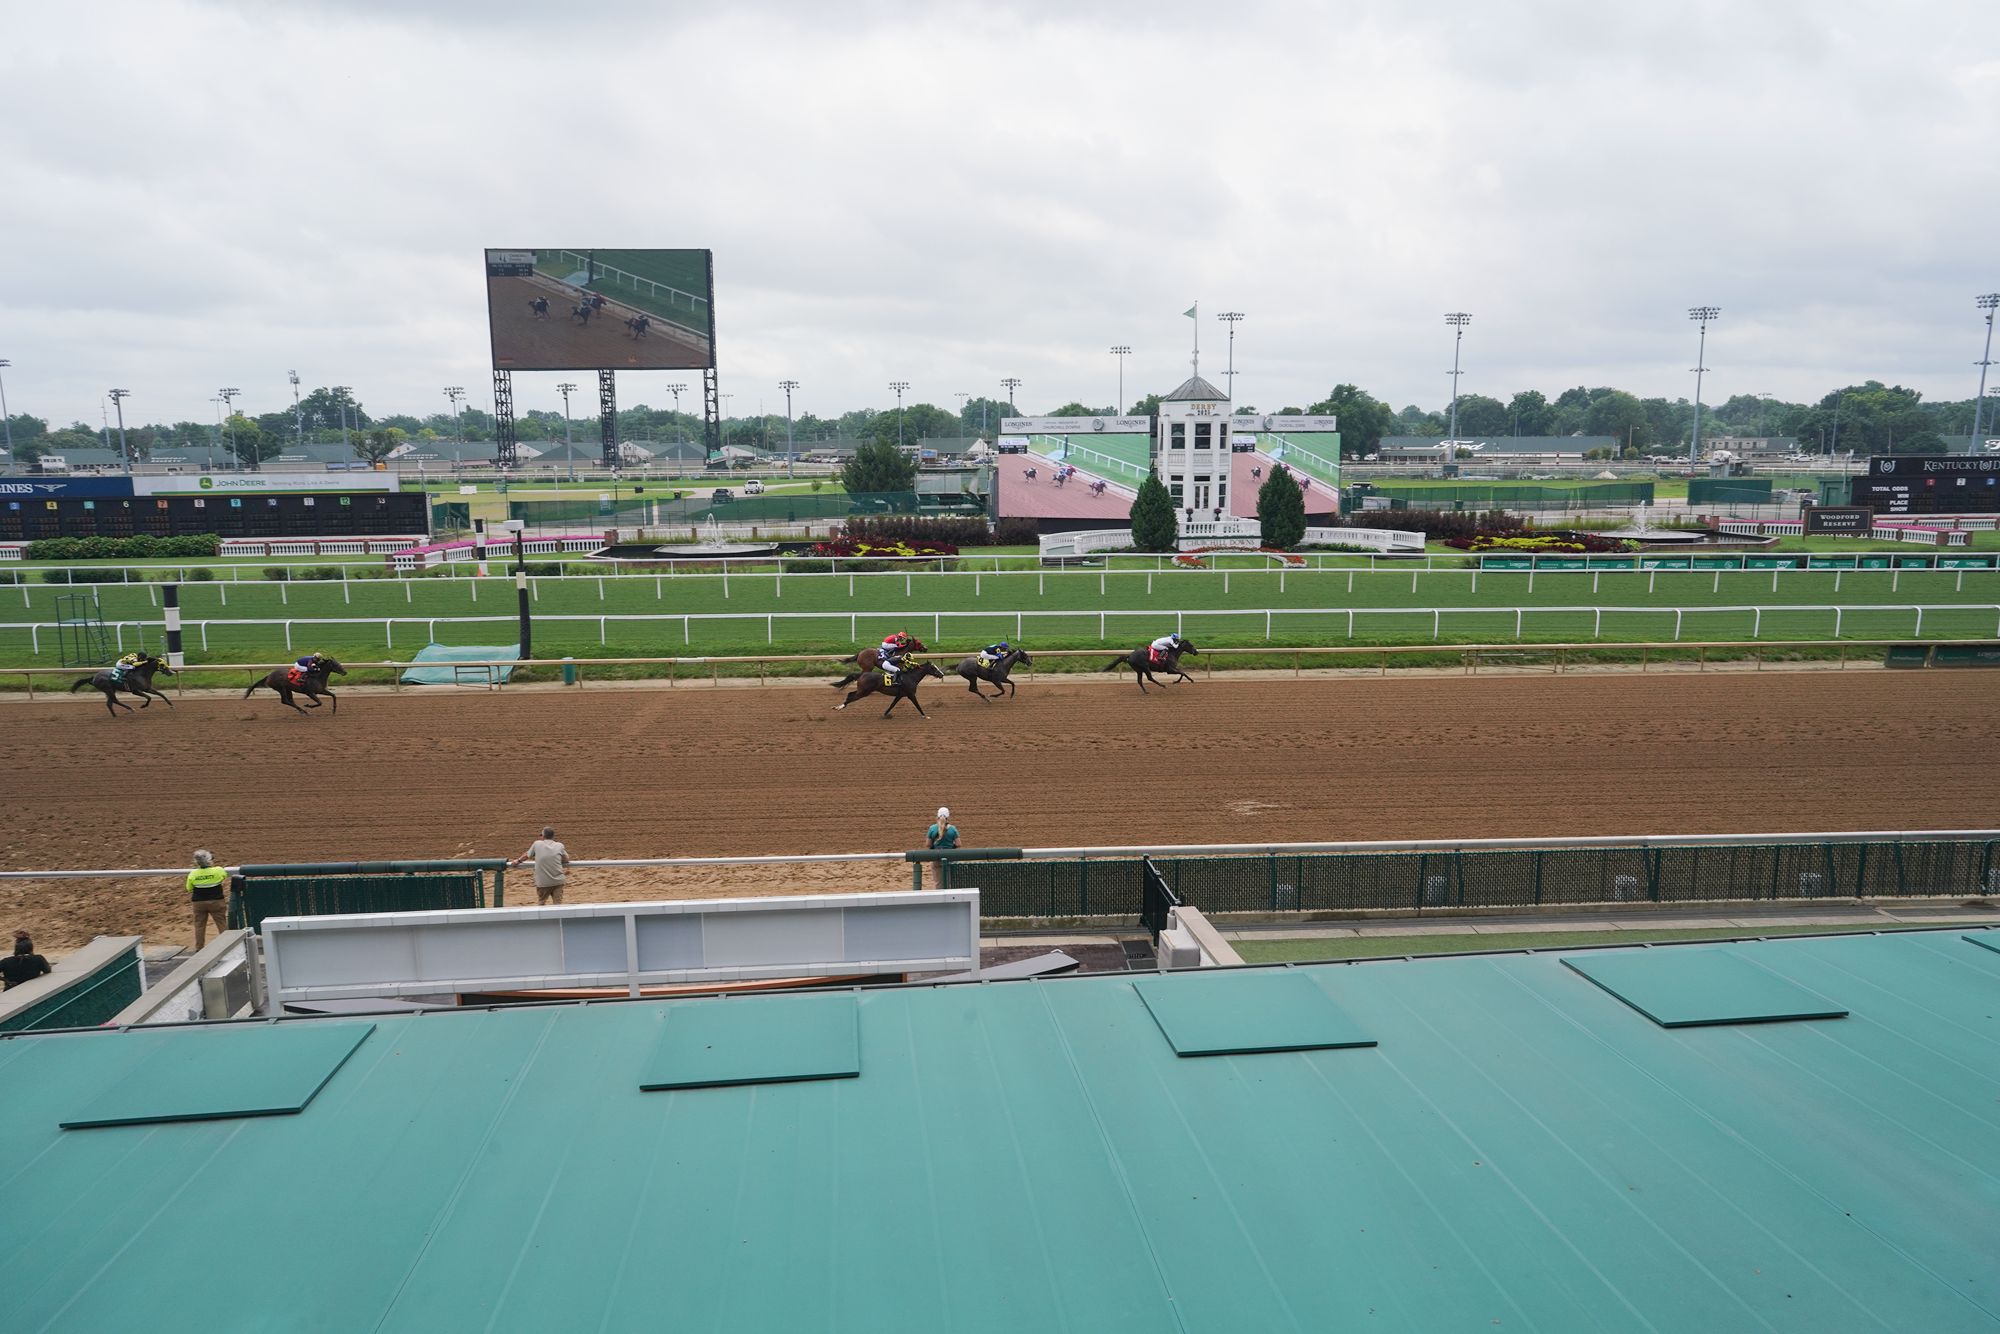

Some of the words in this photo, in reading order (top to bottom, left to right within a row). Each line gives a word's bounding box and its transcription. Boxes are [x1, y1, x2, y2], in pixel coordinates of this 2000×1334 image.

[1432, 440, 1486, 450] Ford
[1923, 460, 1979, 472] KENTUCKY
[0, 484, 34, 494] INES
[112, 668, 120, 680] 5
